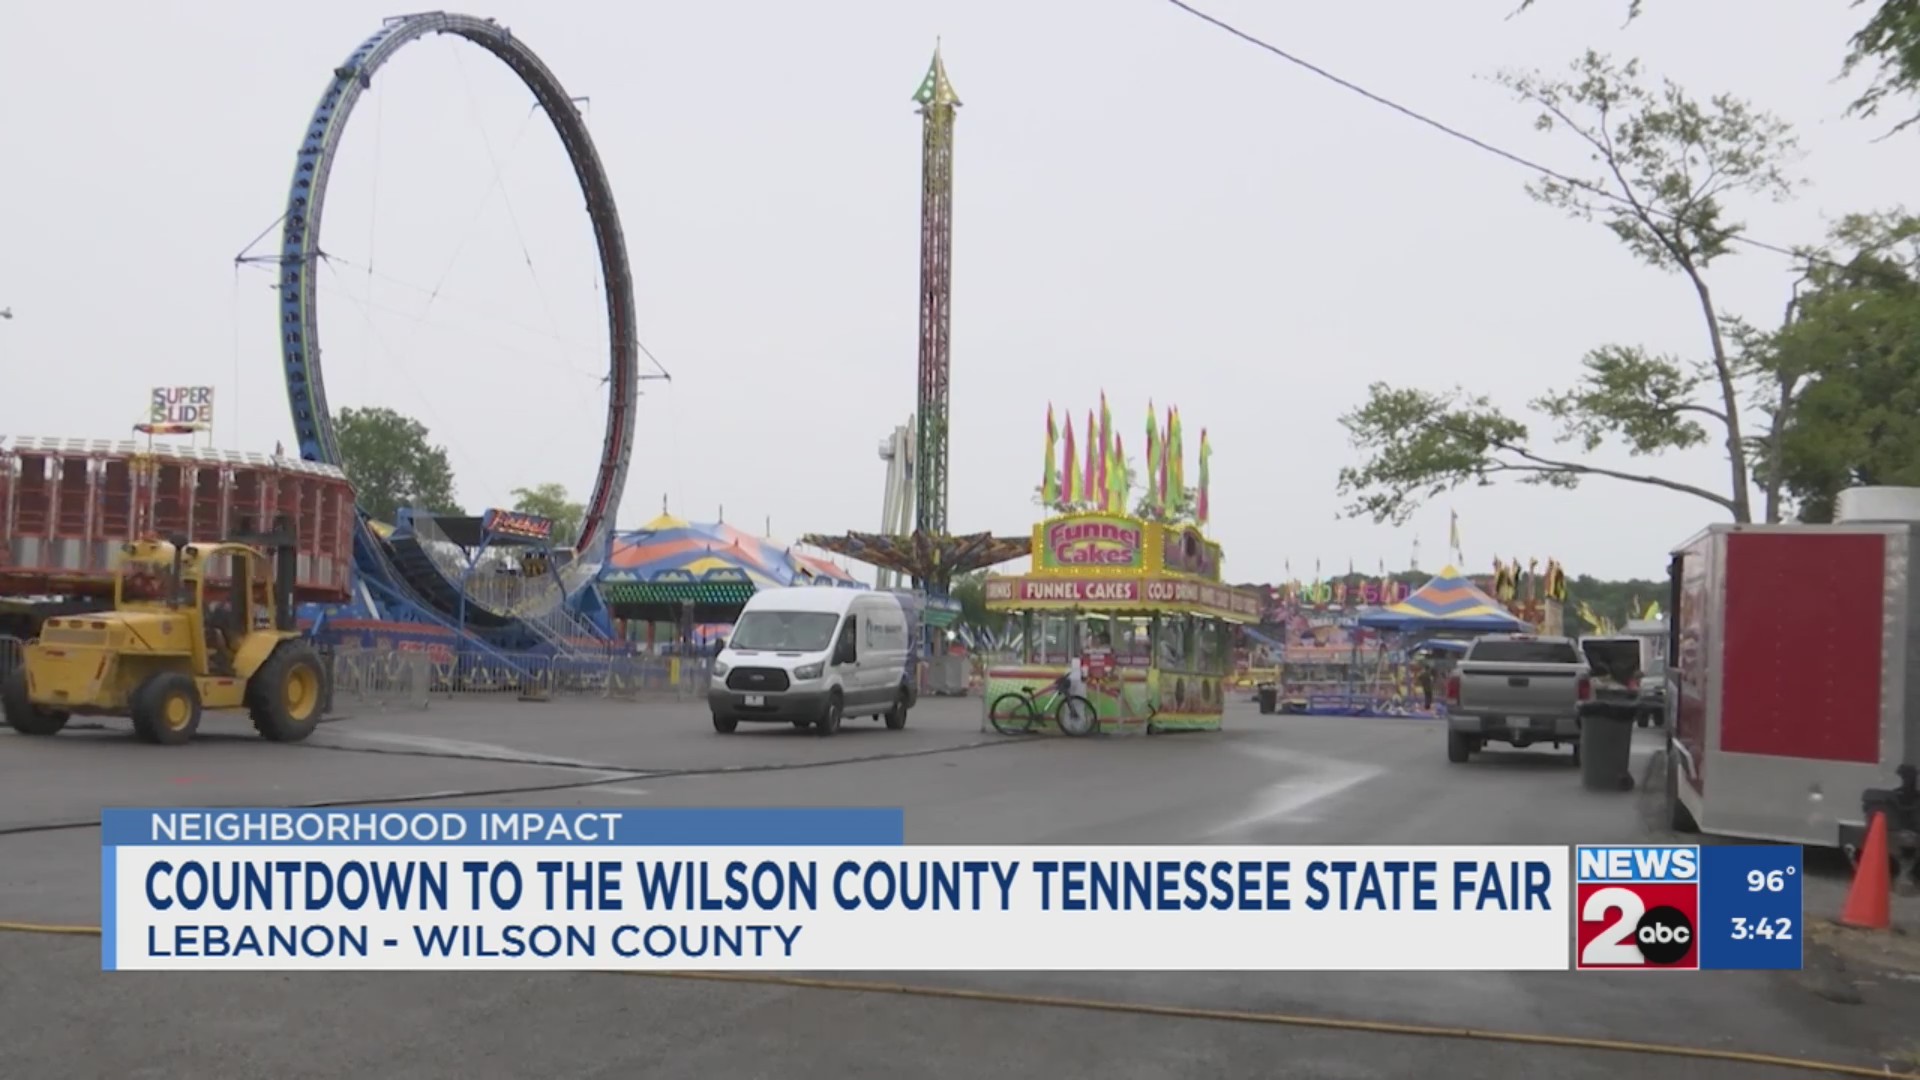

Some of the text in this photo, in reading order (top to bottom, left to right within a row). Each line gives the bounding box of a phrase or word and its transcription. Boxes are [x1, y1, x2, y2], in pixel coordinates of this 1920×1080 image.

[152, 386, 210, 404] SUPER
[151, 404, 211, 423] SLIDE
[1050, 522, 1140, 550] Funnel
[1056, 542, 1133, 563] Cakes
[1026, 582, 1132, 599] FUNNEL CAKES
[1148, 582, 1174, 600] COLD
